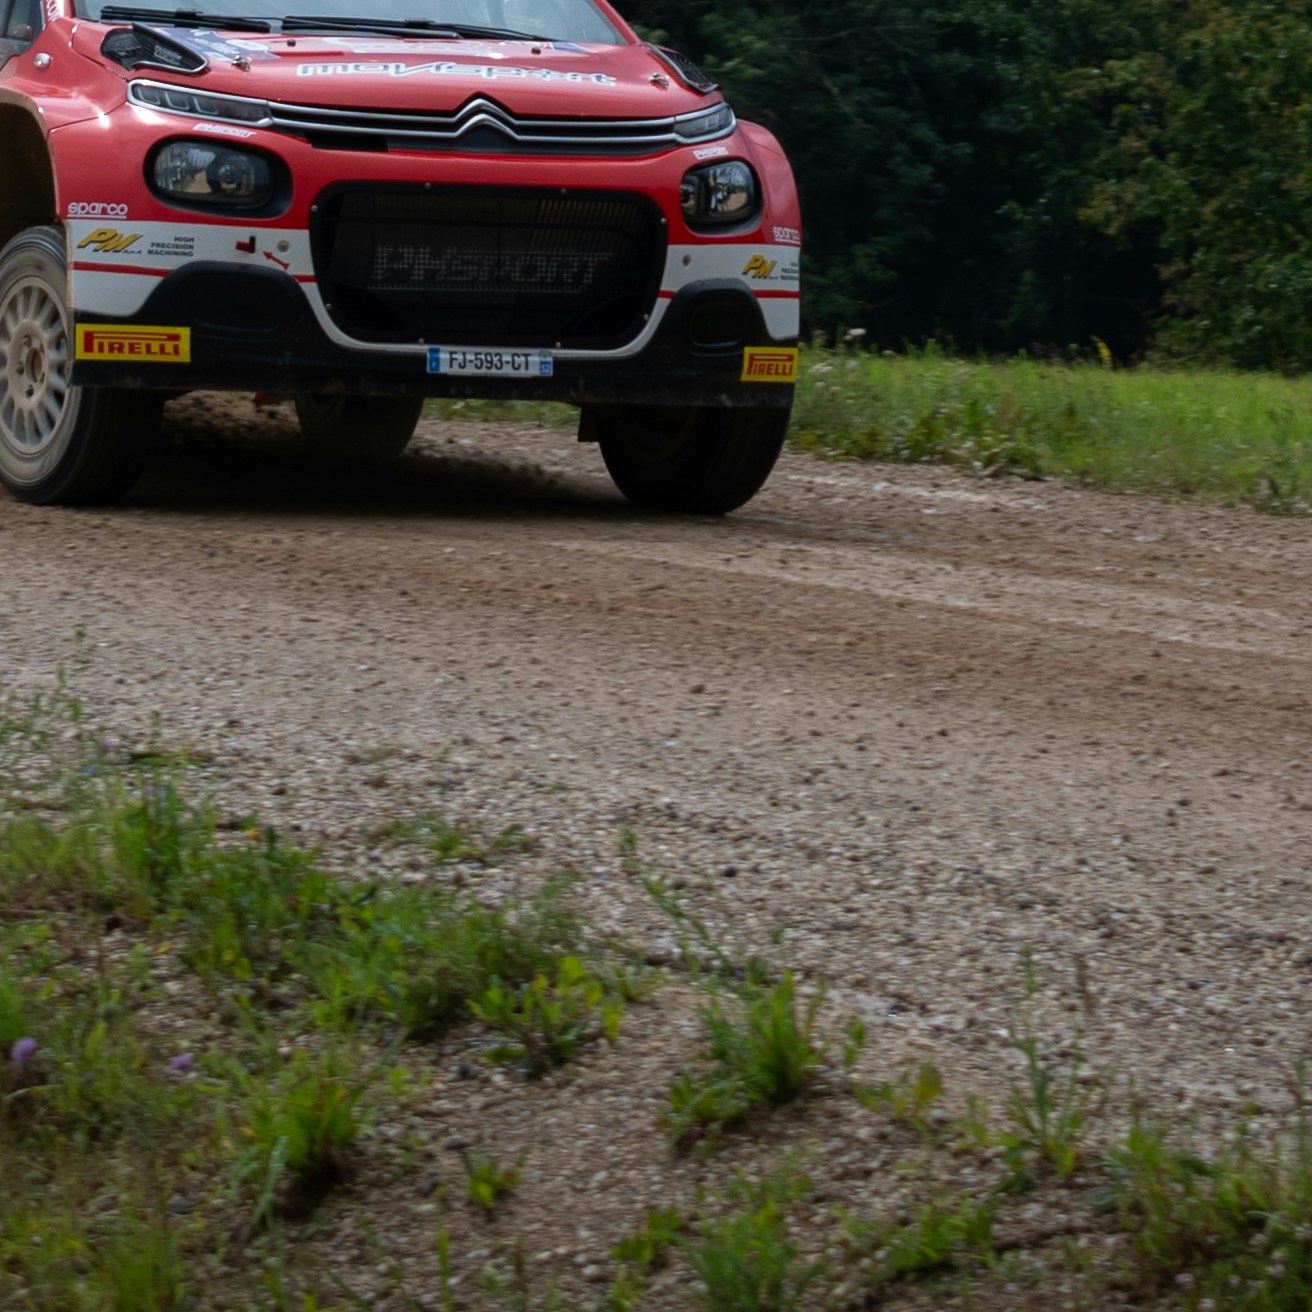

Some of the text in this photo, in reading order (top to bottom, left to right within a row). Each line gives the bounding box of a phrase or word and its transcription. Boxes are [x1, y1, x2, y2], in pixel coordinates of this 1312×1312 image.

[67, 201, 128, 219] sparco
[76, 228, 143, 253] PM
[151, 242, 195, 250] PRECISION
[147, 249, 194, 257] MACHINING
[83, 330, 181, 356] PIRELLI
[448, 351, 531, 371] FJ-593-CT
[746, 353, 794, 376] PIRELLI
